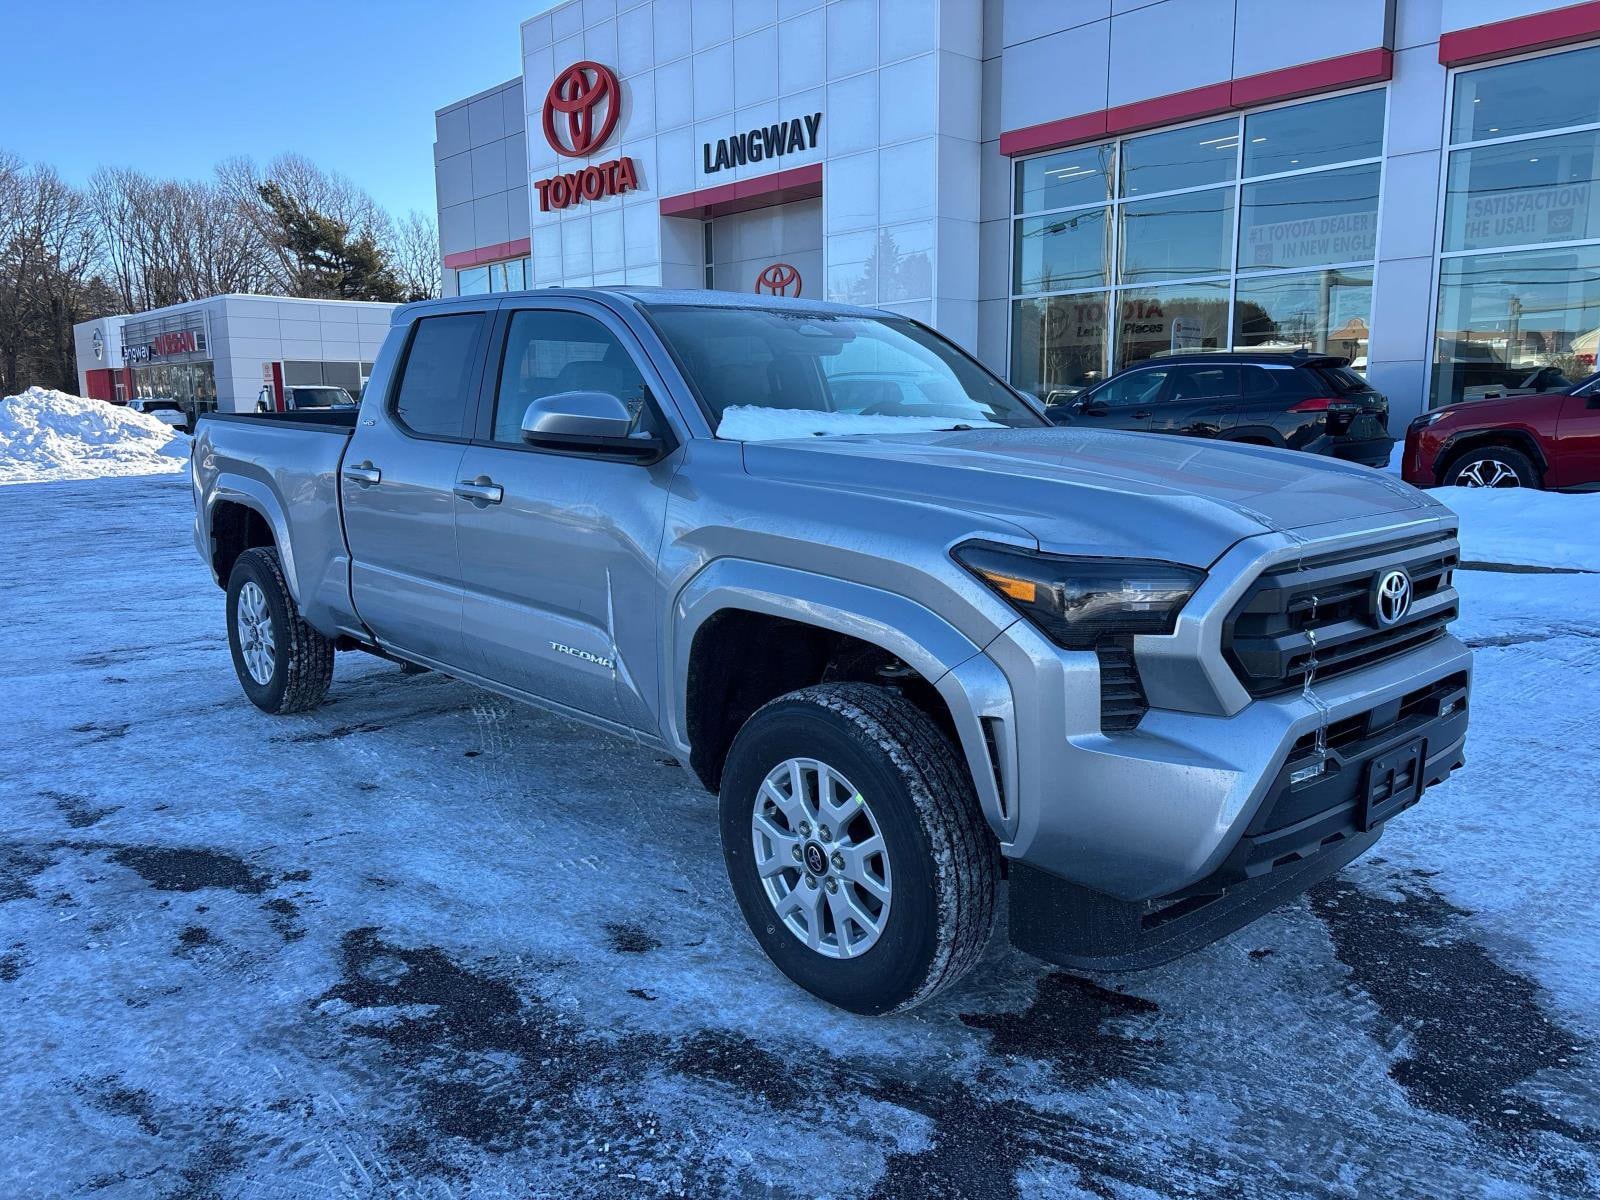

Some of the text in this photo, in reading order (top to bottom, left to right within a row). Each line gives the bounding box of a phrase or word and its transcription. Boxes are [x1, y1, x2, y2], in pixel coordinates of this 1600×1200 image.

[704, 112, 821, 174] LANGWAY
[535, 157, 637, 211] TOYOTA
[1474, 187, 1585, 217] SATISFACTION
[1249, 229, 1263, 244] #1
[1267, 220, 1316, 241] TOYOTA
[1320, 215, 1367, 233] DEALER
[1495, 215, 1536, 236] USA!!
[1283, 242, 1296, 259] IN
[1300, 239, 1329, 256] NEW
[1074, 302, 1164, 324] TOOTA
[1123, 323, 1164, 335] Places
[154, 331, 198, 357] NISSAN
[549, 641, 614, 668] TACOMA
